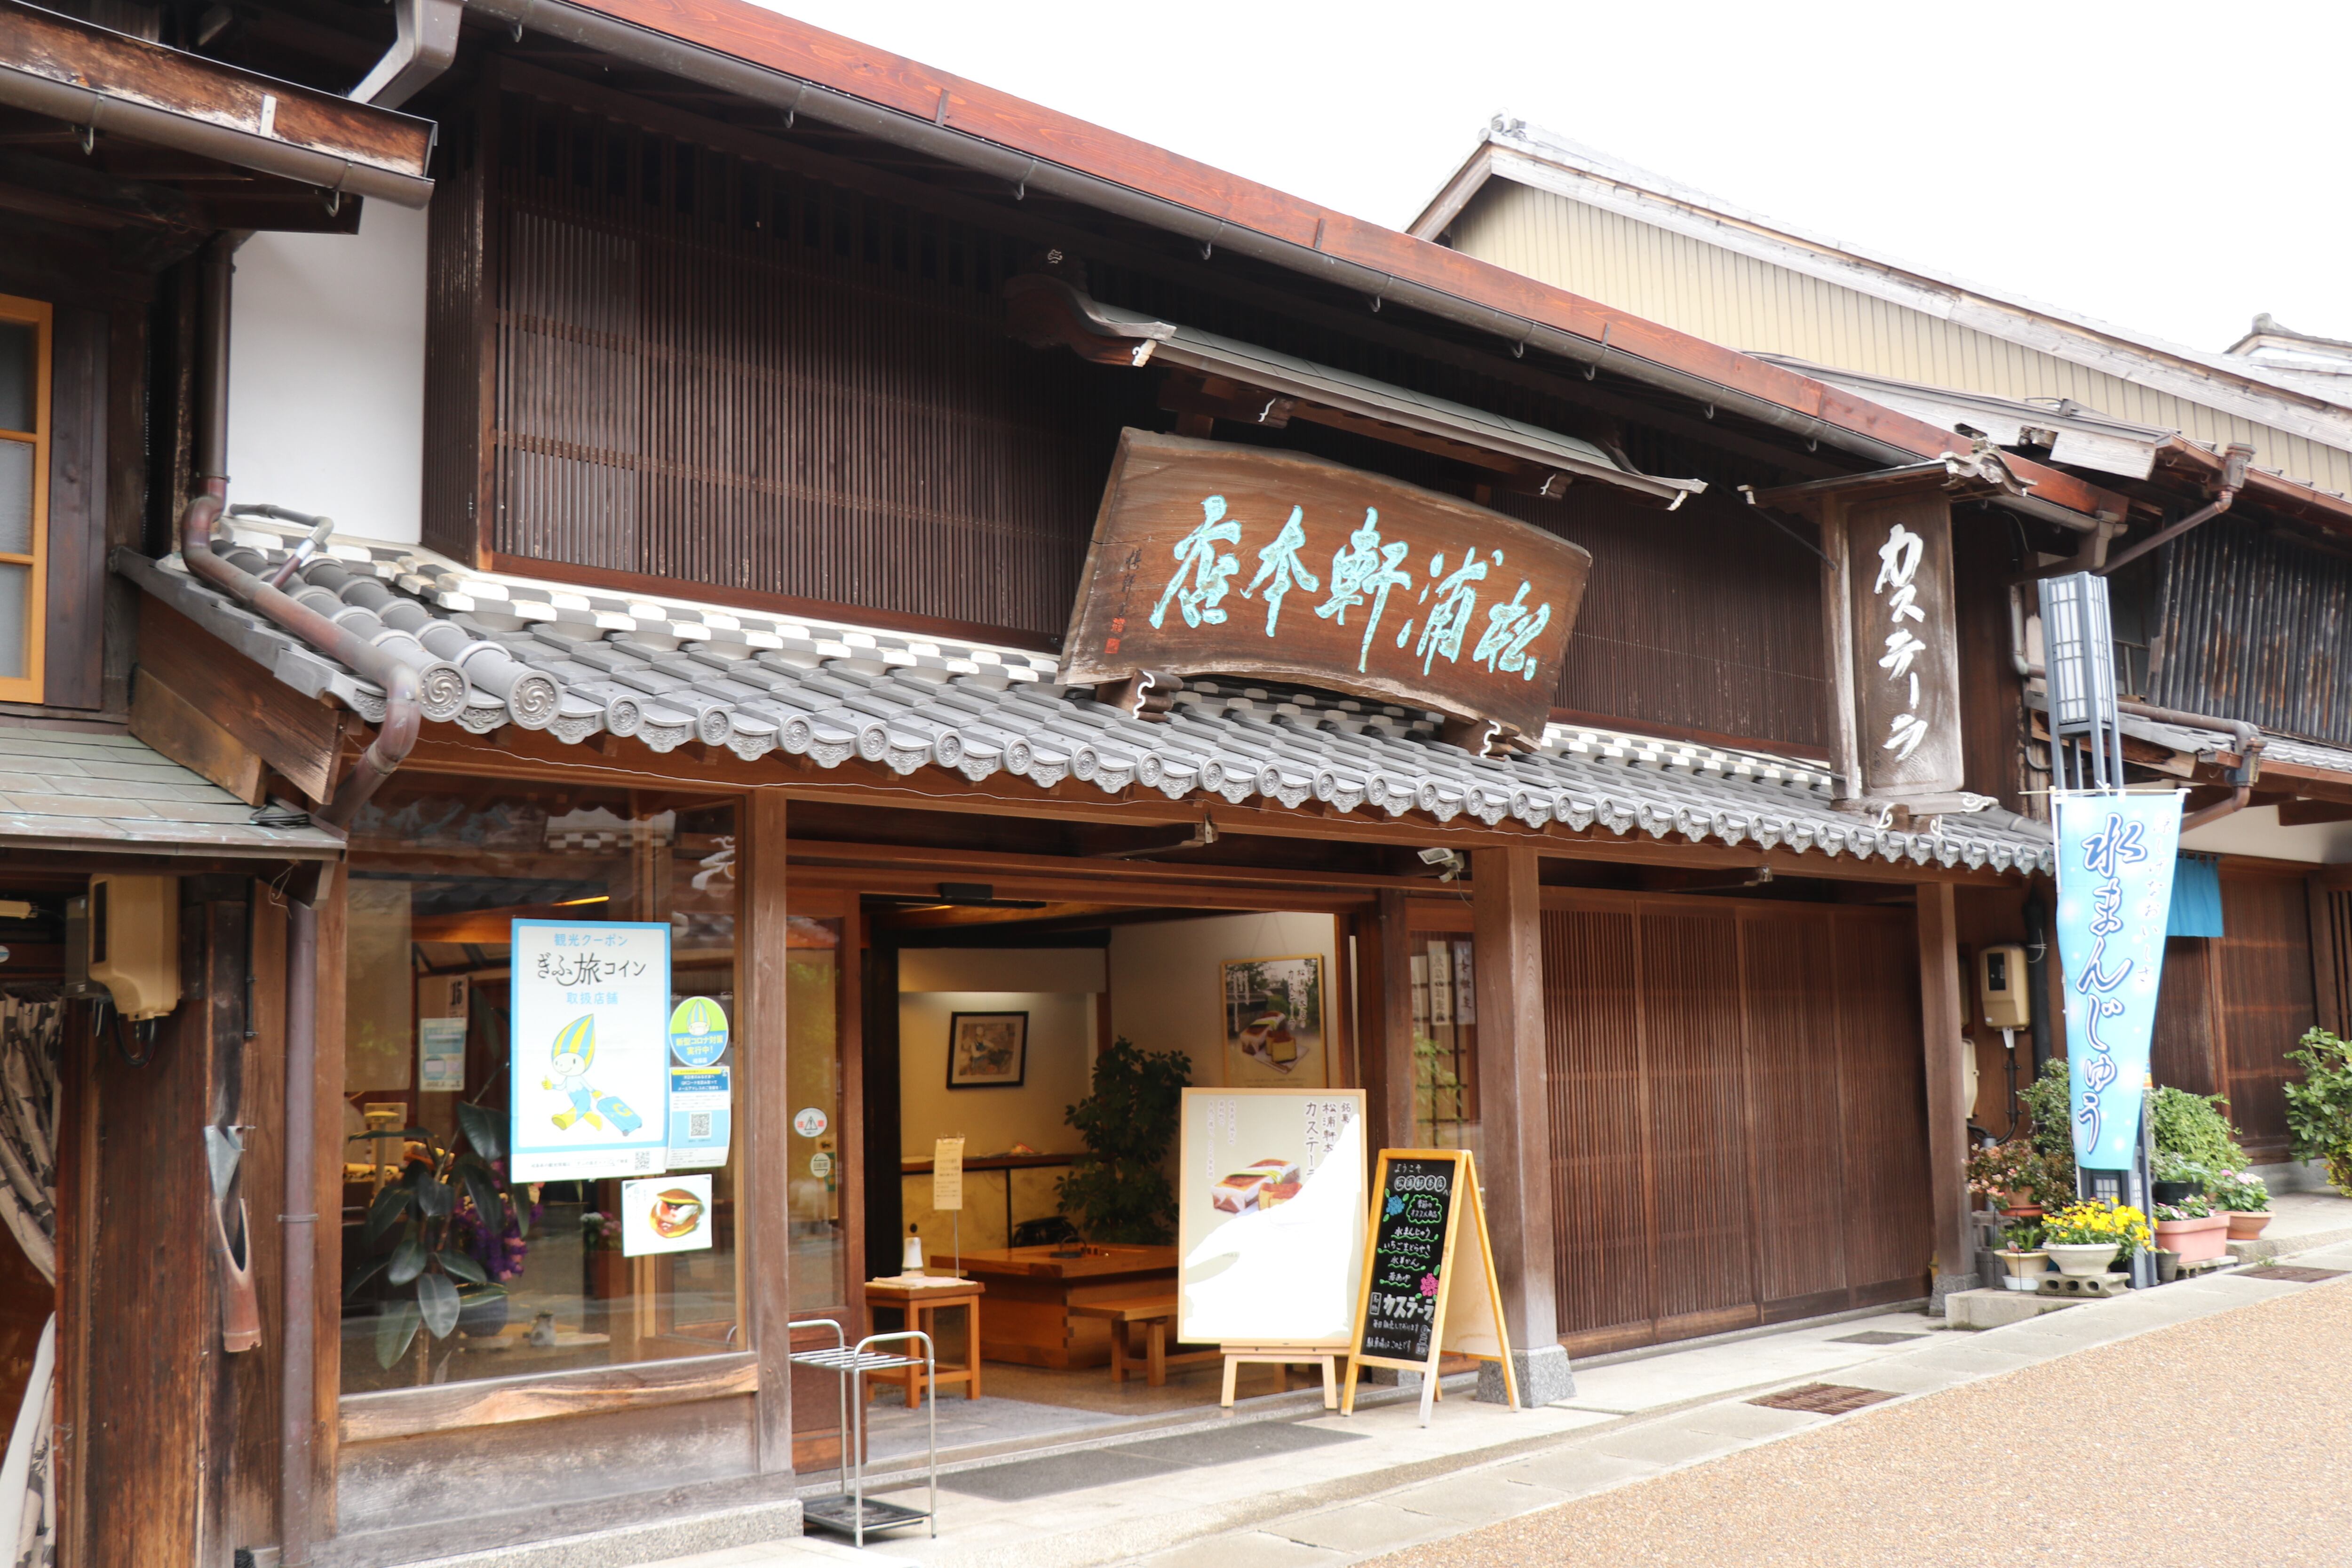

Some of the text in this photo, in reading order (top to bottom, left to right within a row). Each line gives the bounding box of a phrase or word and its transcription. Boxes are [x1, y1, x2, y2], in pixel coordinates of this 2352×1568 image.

[1874, 523, 1928, 762] カステーラ
[554, 933, 628, 947] 観光クーポン
[537, 952, 646, 987] ぎふ旅コイン
[2076, 813, 2146, 1154] 水まんじゅう
[566, 992, 619, 1005] 取扱店舗
[1394, 1163, 1421, 1173] ようこそ
[1394, 1226, 1430, 1238] 水まんじゅう
[1383, 1294, 1434, 1321] カステーラ
